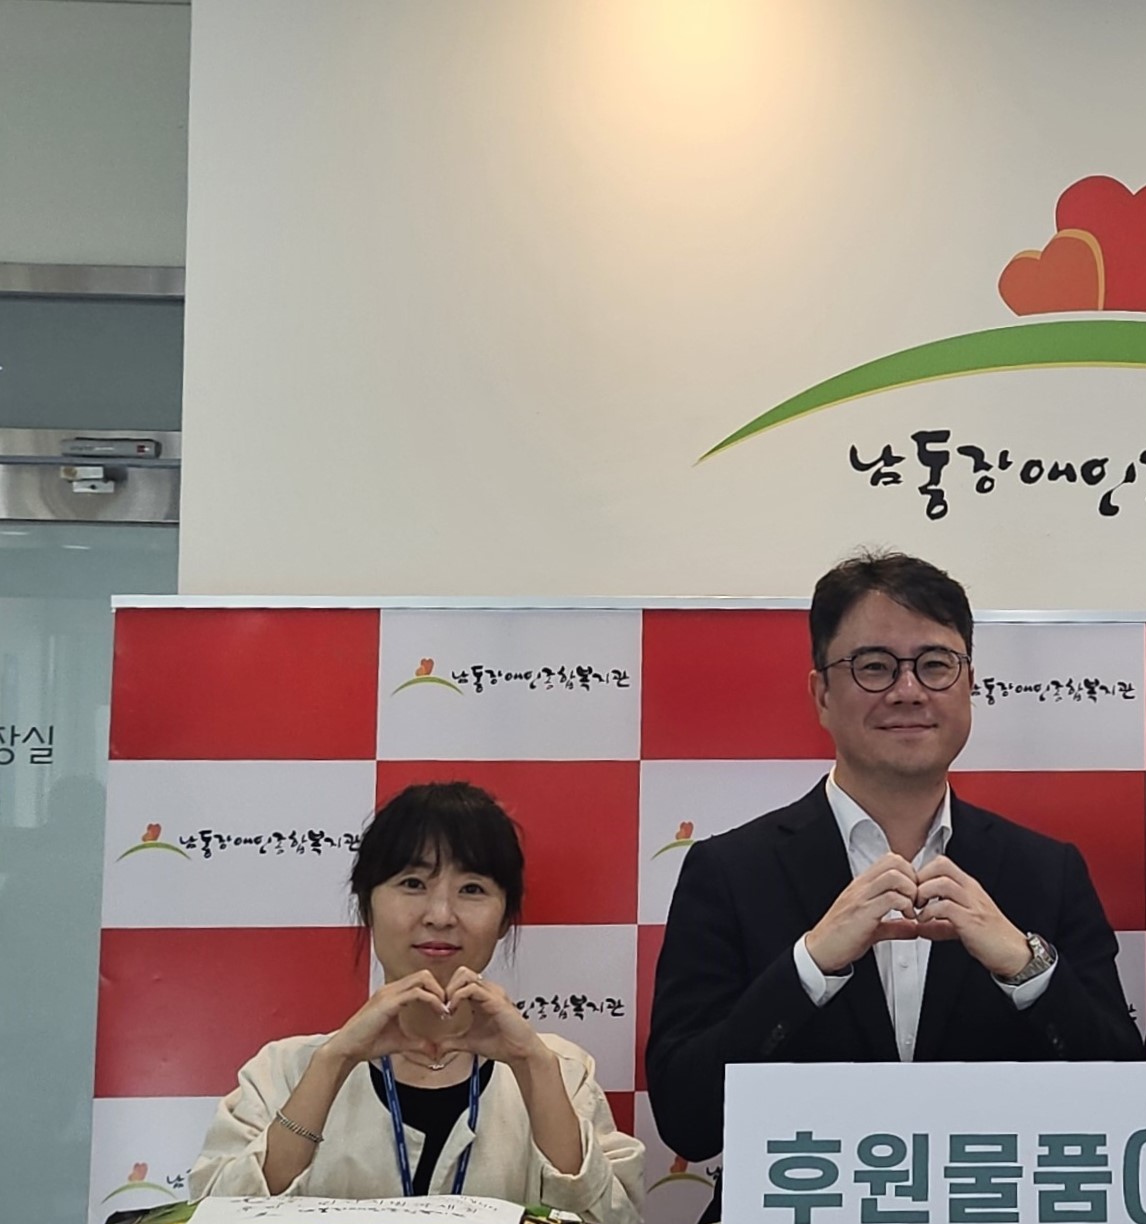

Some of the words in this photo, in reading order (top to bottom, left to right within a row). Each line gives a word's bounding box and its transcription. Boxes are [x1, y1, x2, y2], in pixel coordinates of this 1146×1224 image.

[452, 665, 631, 693] 남동장애인종합복지관
[0, 725, 54, 765] 장실
[513, 994, 625, 1021] 인종합복지관
